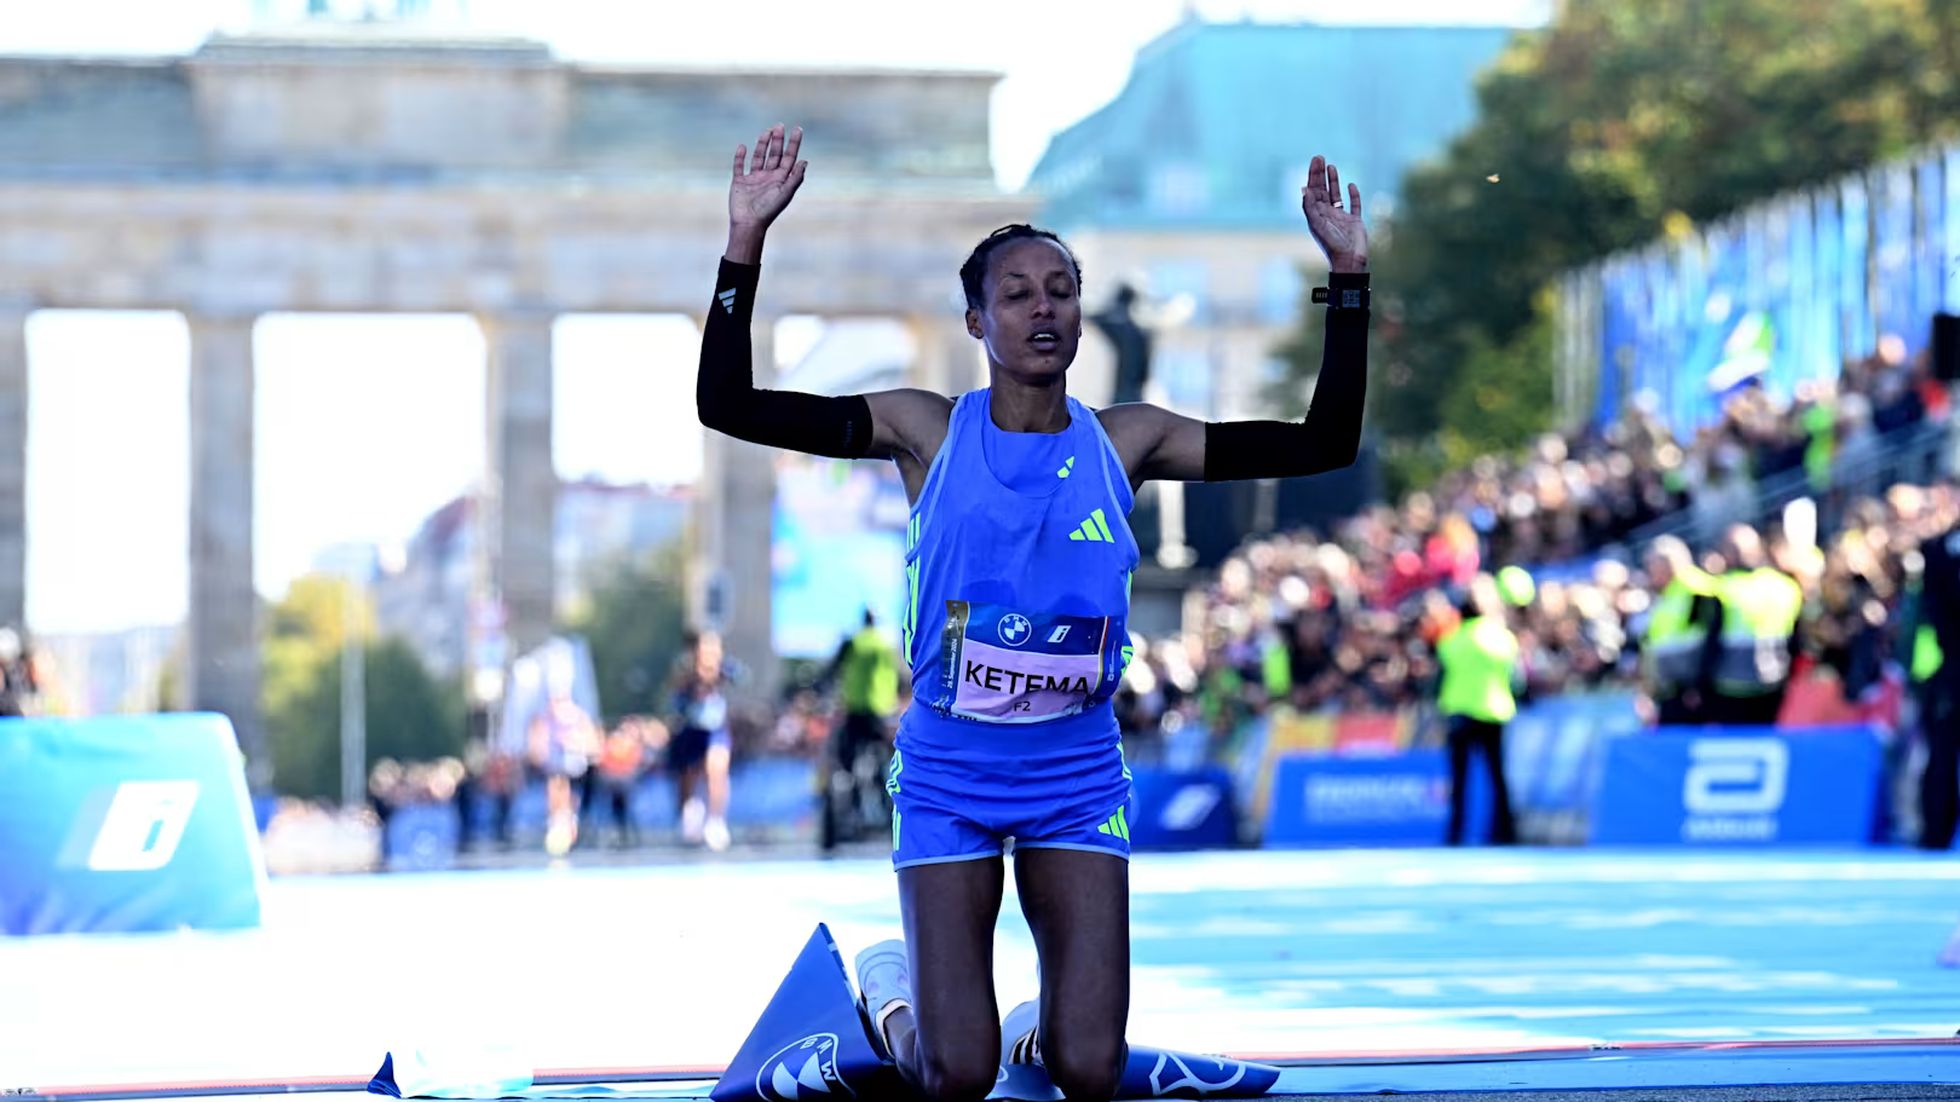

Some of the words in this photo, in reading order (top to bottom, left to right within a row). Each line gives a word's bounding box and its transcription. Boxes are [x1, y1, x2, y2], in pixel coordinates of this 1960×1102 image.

[965, 660, 1089, 695] KETEMA
[1013, 701, 1031, 712] F2
[800, 1037, 838, 1081] BMW
